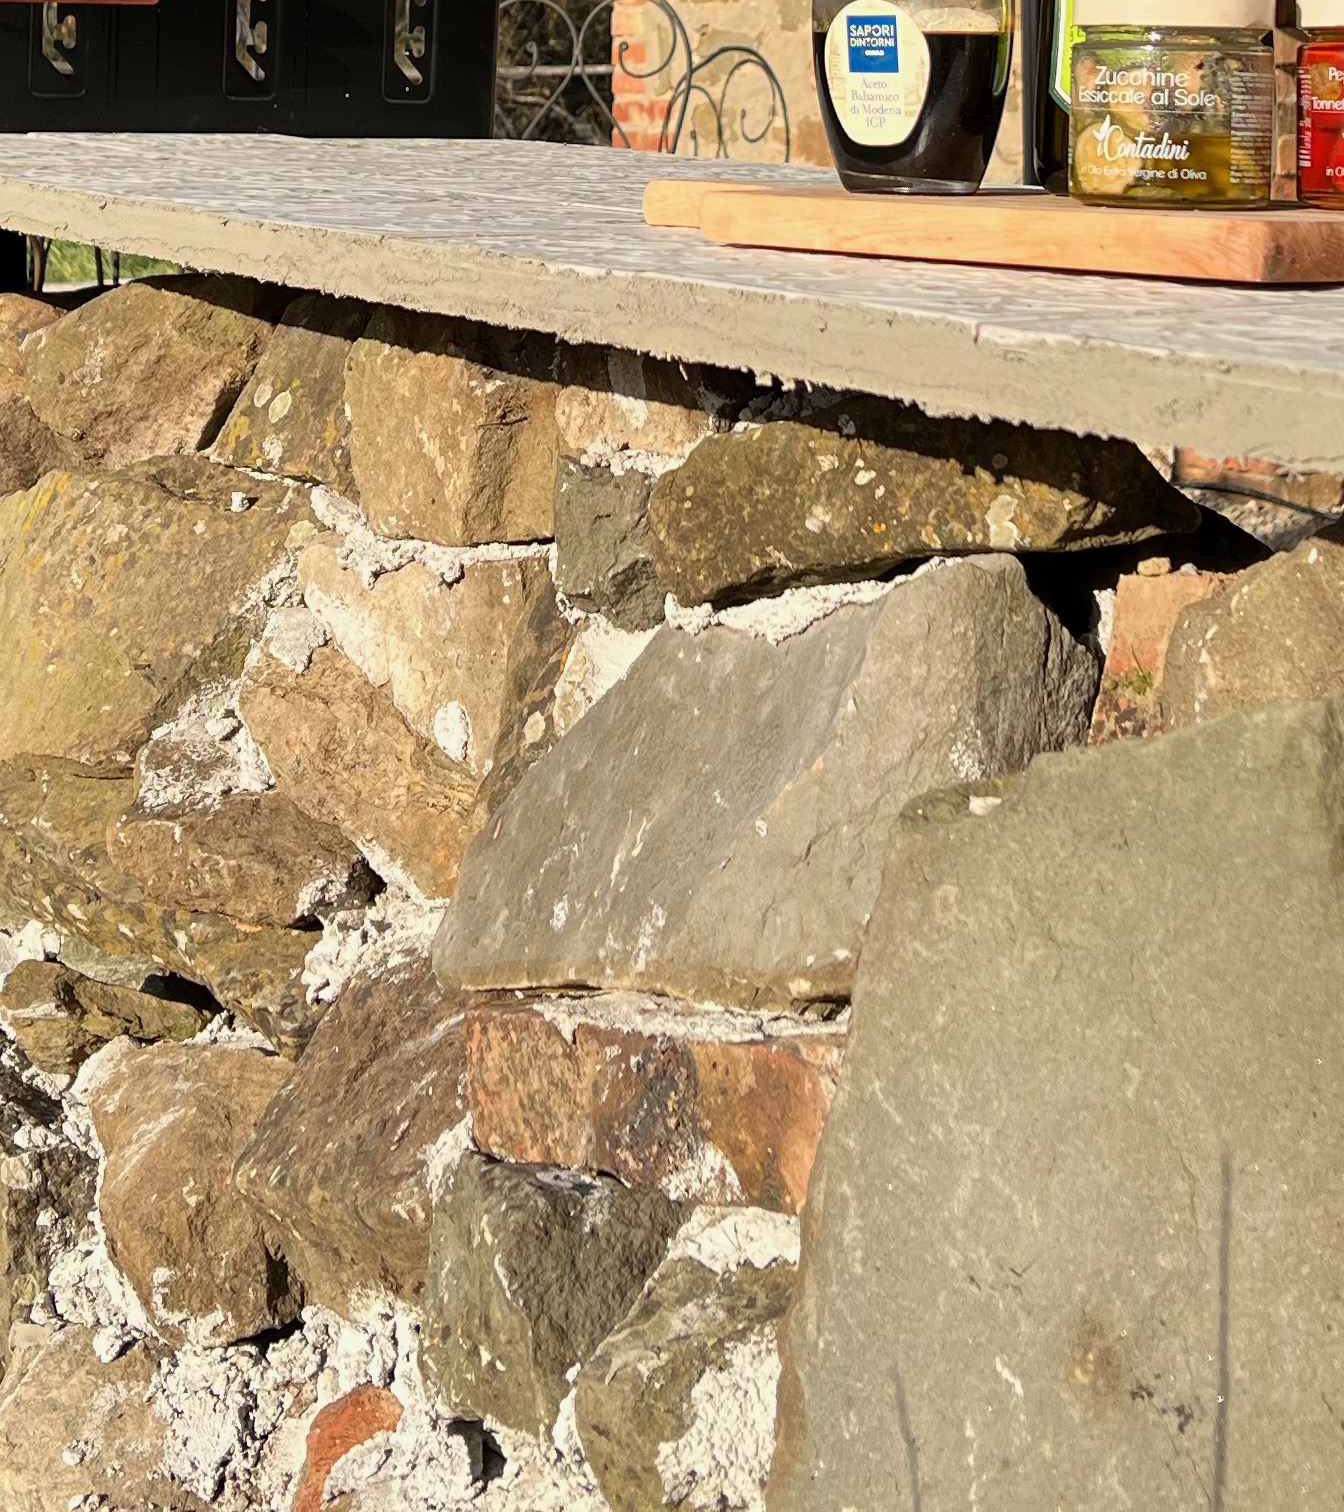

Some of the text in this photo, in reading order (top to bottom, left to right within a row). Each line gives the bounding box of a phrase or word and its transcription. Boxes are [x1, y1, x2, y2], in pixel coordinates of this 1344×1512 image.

[849, 24, 894, 37] SAPORI
[861, 78, 888, 89] Aceto
[851, 90, 900, 102] Balsamico
[1078, 86, 1216, 107] Essiccate al Sole
[850, 104, 901, 115] di Modena
[866, 117, 886, 128] IGP
[1326, 166, 1334, 176] in
